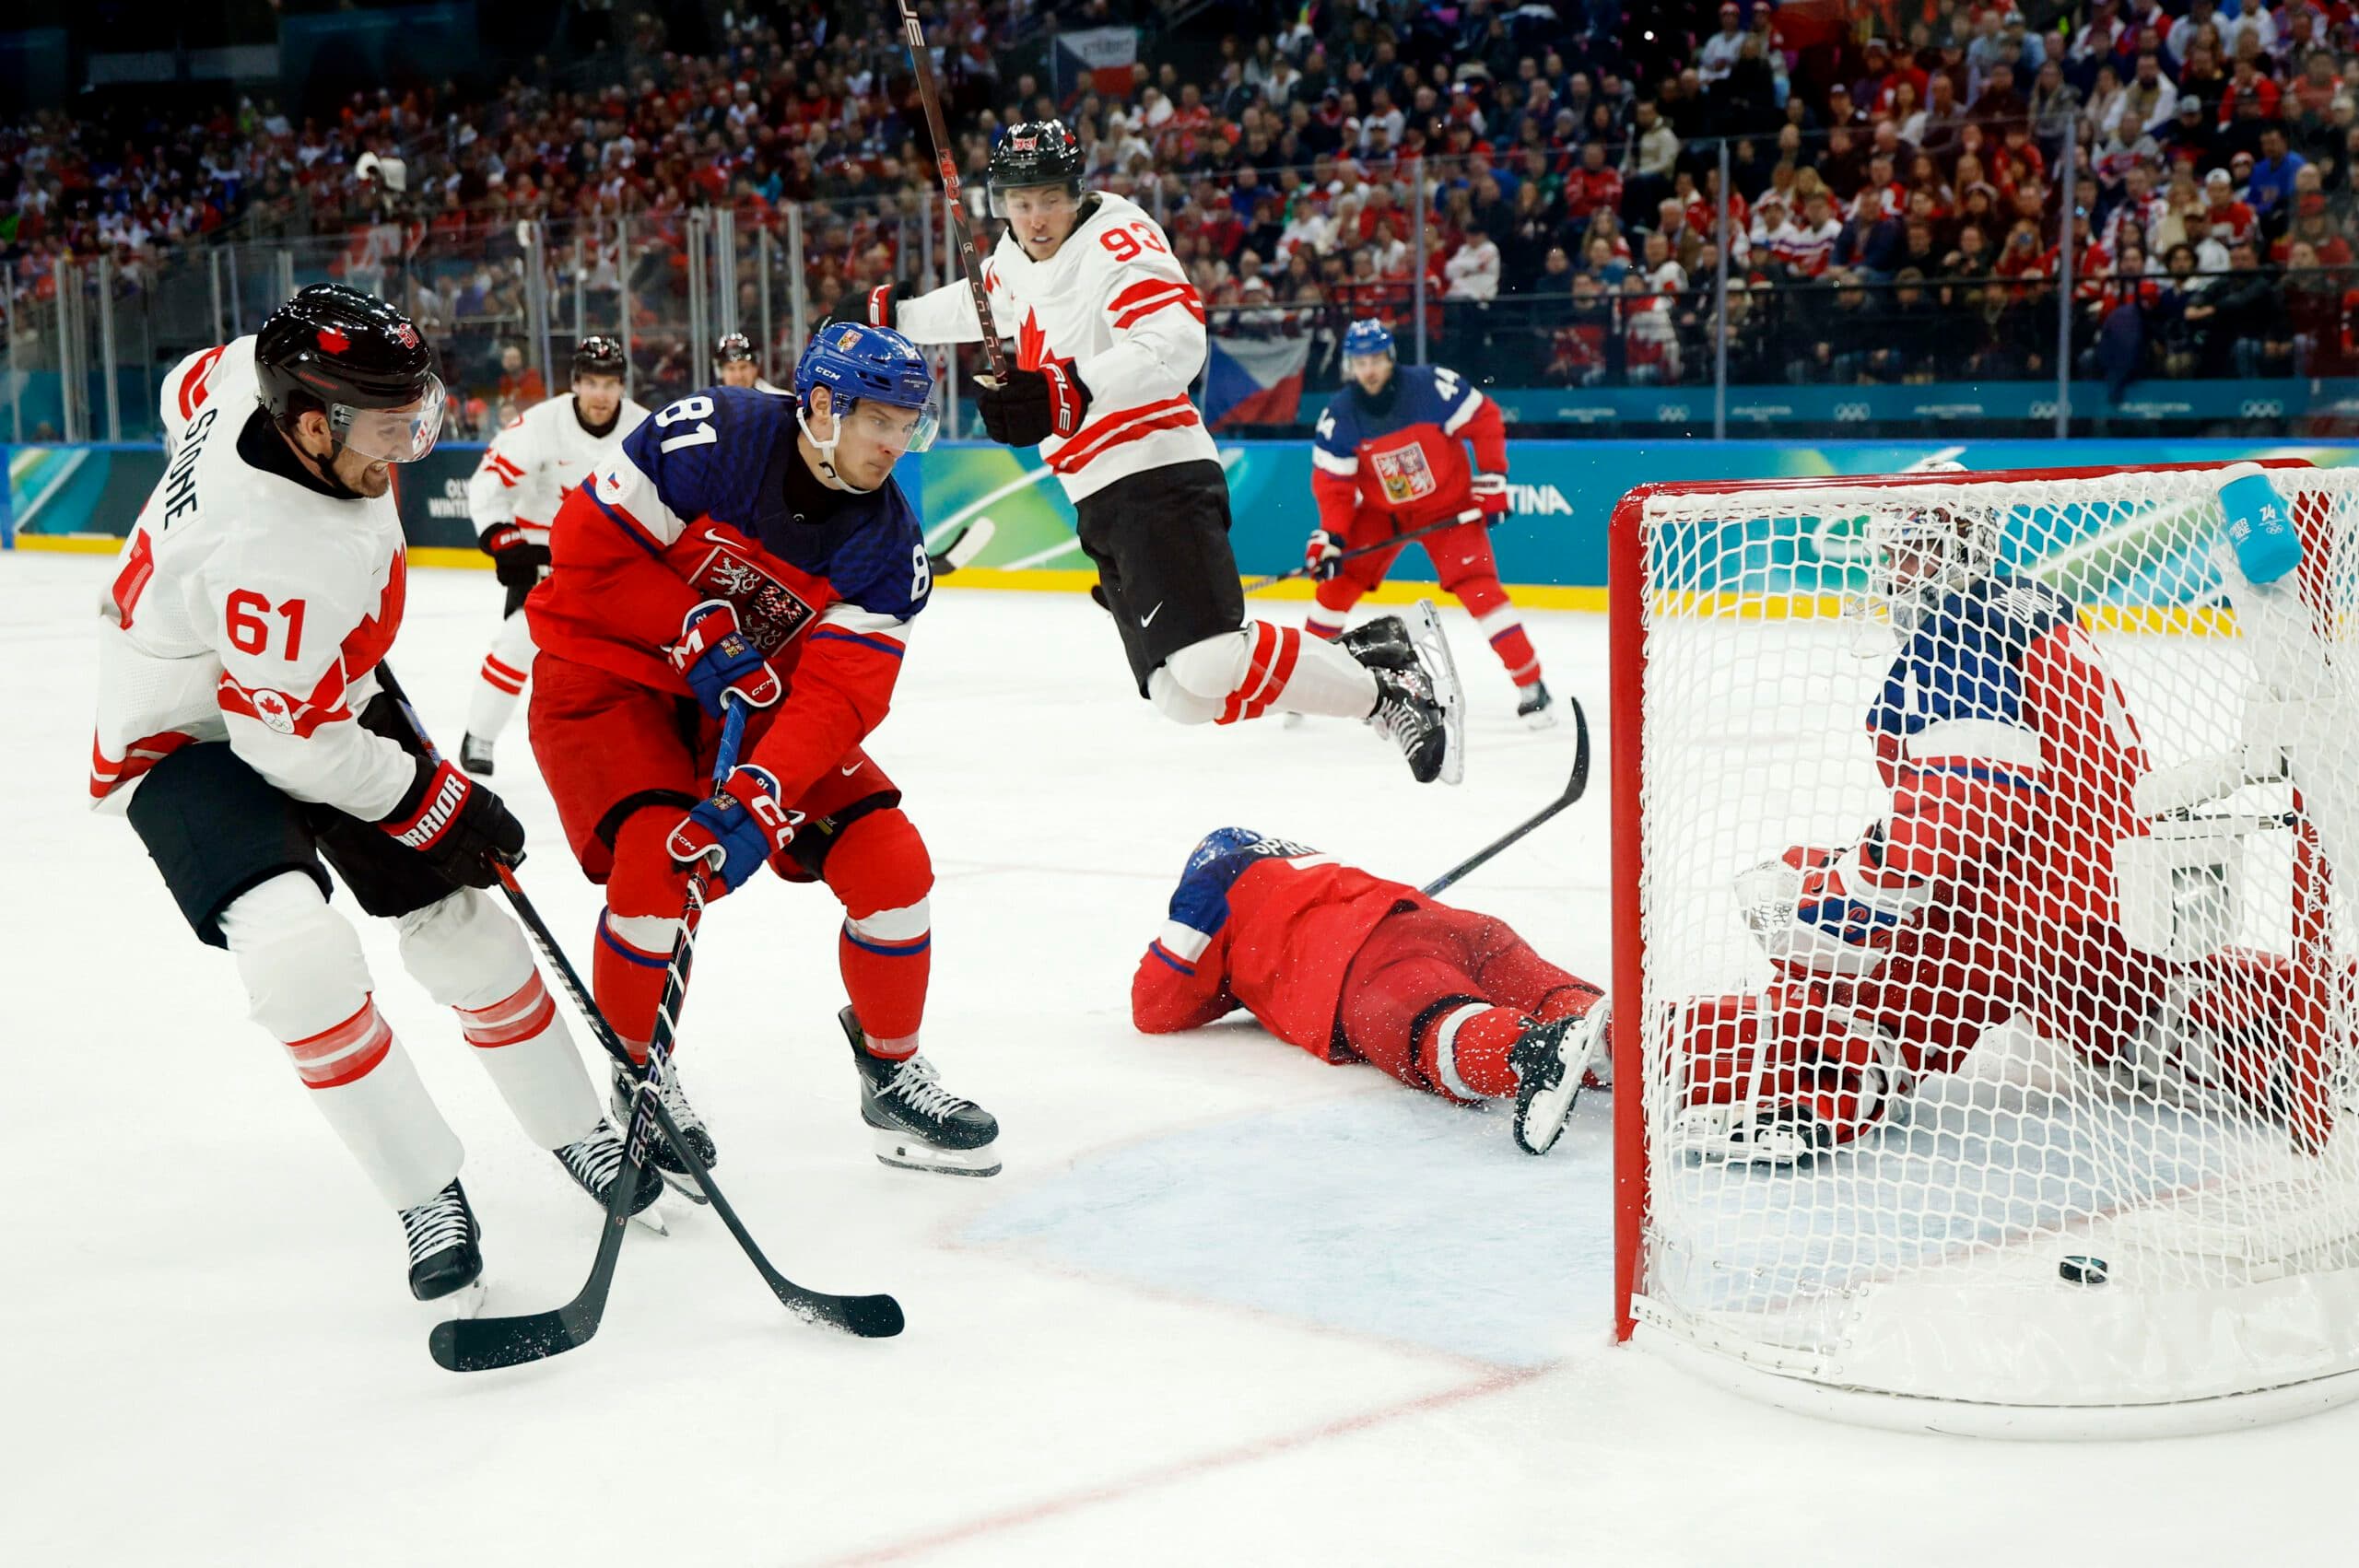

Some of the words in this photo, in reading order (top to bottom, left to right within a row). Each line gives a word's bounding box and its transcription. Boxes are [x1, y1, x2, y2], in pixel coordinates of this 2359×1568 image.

[1099, 221, 1167, 263] 93
[815, 366, 840, 380] CCM
[654, 395, 718, 454] 81
[1507, 484, 1574, 515] TINA
[910, 544, 930, 602] 8
[226, 588, 306, 661] 61
